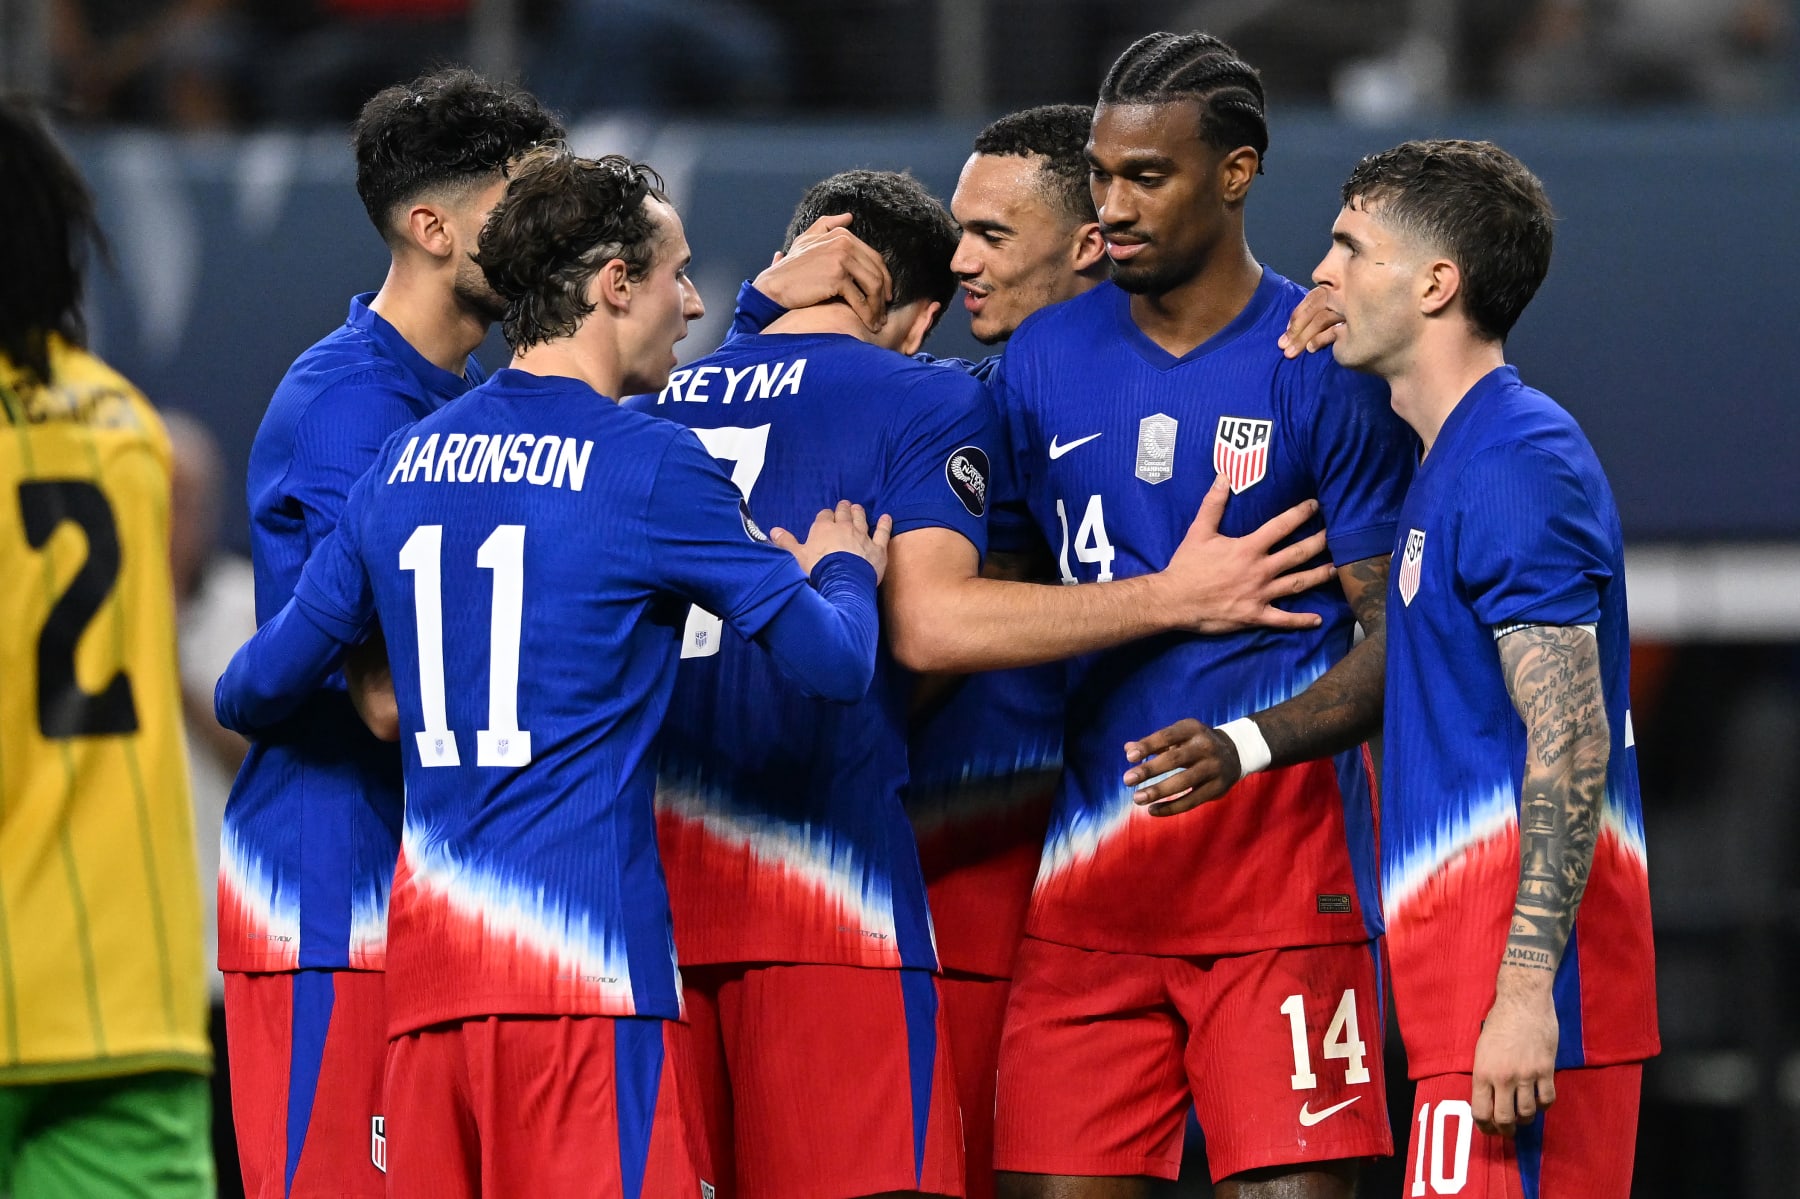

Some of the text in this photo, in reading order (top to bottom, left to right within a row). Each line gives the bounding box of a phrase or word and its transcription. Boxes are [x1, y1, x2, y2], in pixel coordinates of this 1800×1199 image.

[658, 358, 808, 405] REYNA
[387, 433, 595, 491] AARONSON
[1220, 420, 1269, 450] USA
[1056, 494, 1115, 586] 14
[1406, 533, 1424, 562] USA
[18, 479, 140, 741] 2
[399, 524, 532, 768] 11
[1507, 947, 1549, 964] MMXIII
[1280, 988, 1371, 1090] 14
[1411, 1099, 1474, 1198] 10
